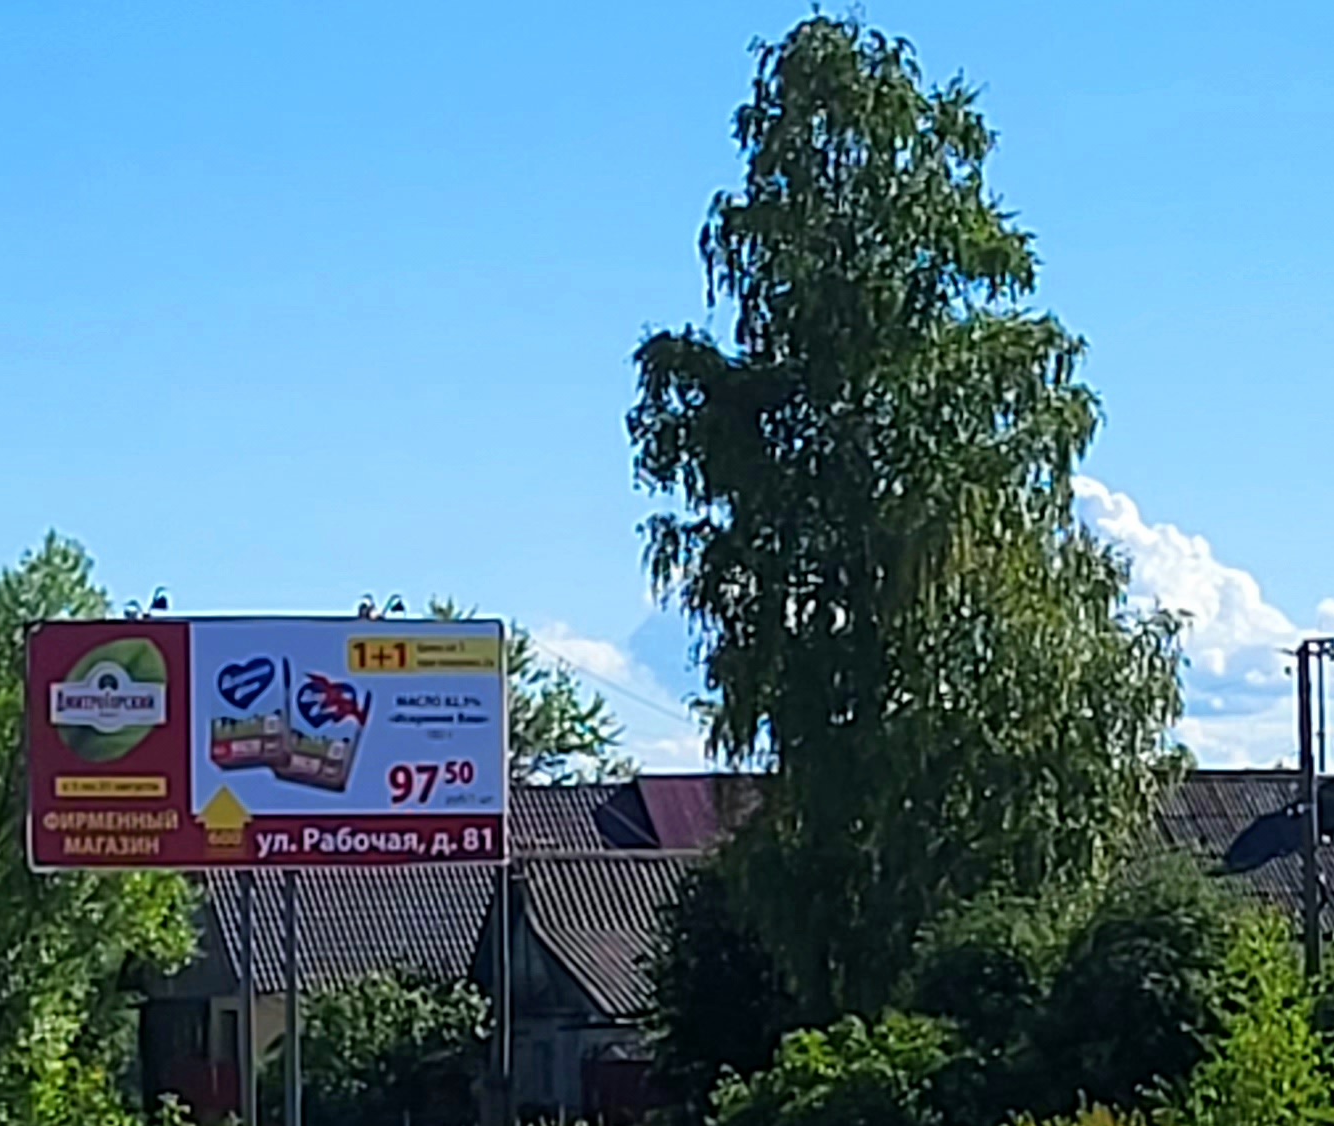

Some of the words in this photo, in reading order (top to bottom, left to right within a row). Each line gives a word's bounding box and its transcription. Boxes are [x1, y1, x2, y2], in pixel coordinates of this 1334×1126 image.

[352, 642, 406, 669] 1+1
[389, 765, 439, 804] 97
[445, 761, 474, 785] 50
[43, 809, 178, 831] ФИРМЕННЫЙ
[64, 836, 159, 854] МАГАЗИН
[256, 833, 297, 858] ул.
[303, 827, 426, 854] Рабочая,
[430, 832, 458, 855] д.
[463, 827, 493, 851] 81
